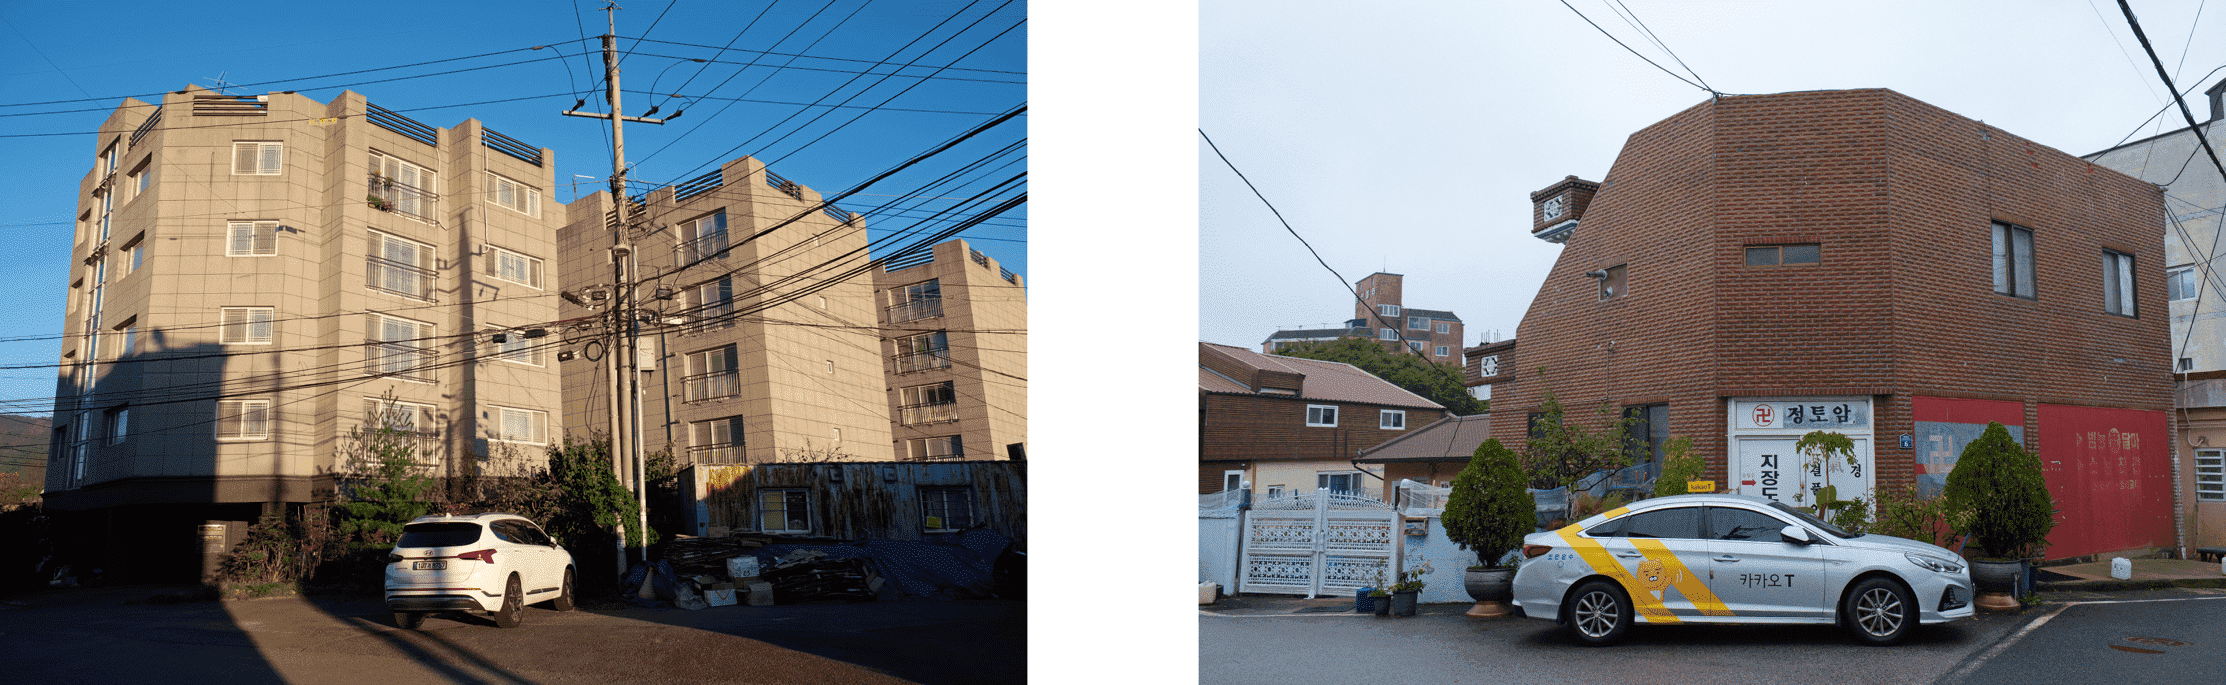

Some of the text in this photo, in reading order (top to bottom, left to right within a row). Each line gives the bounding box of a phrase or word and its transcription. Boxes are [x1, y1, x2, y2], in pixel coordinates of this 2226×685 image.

[1787, 404, 1851, 424] 정토암
[1740, 573, 1795, 588] 카카오 T
